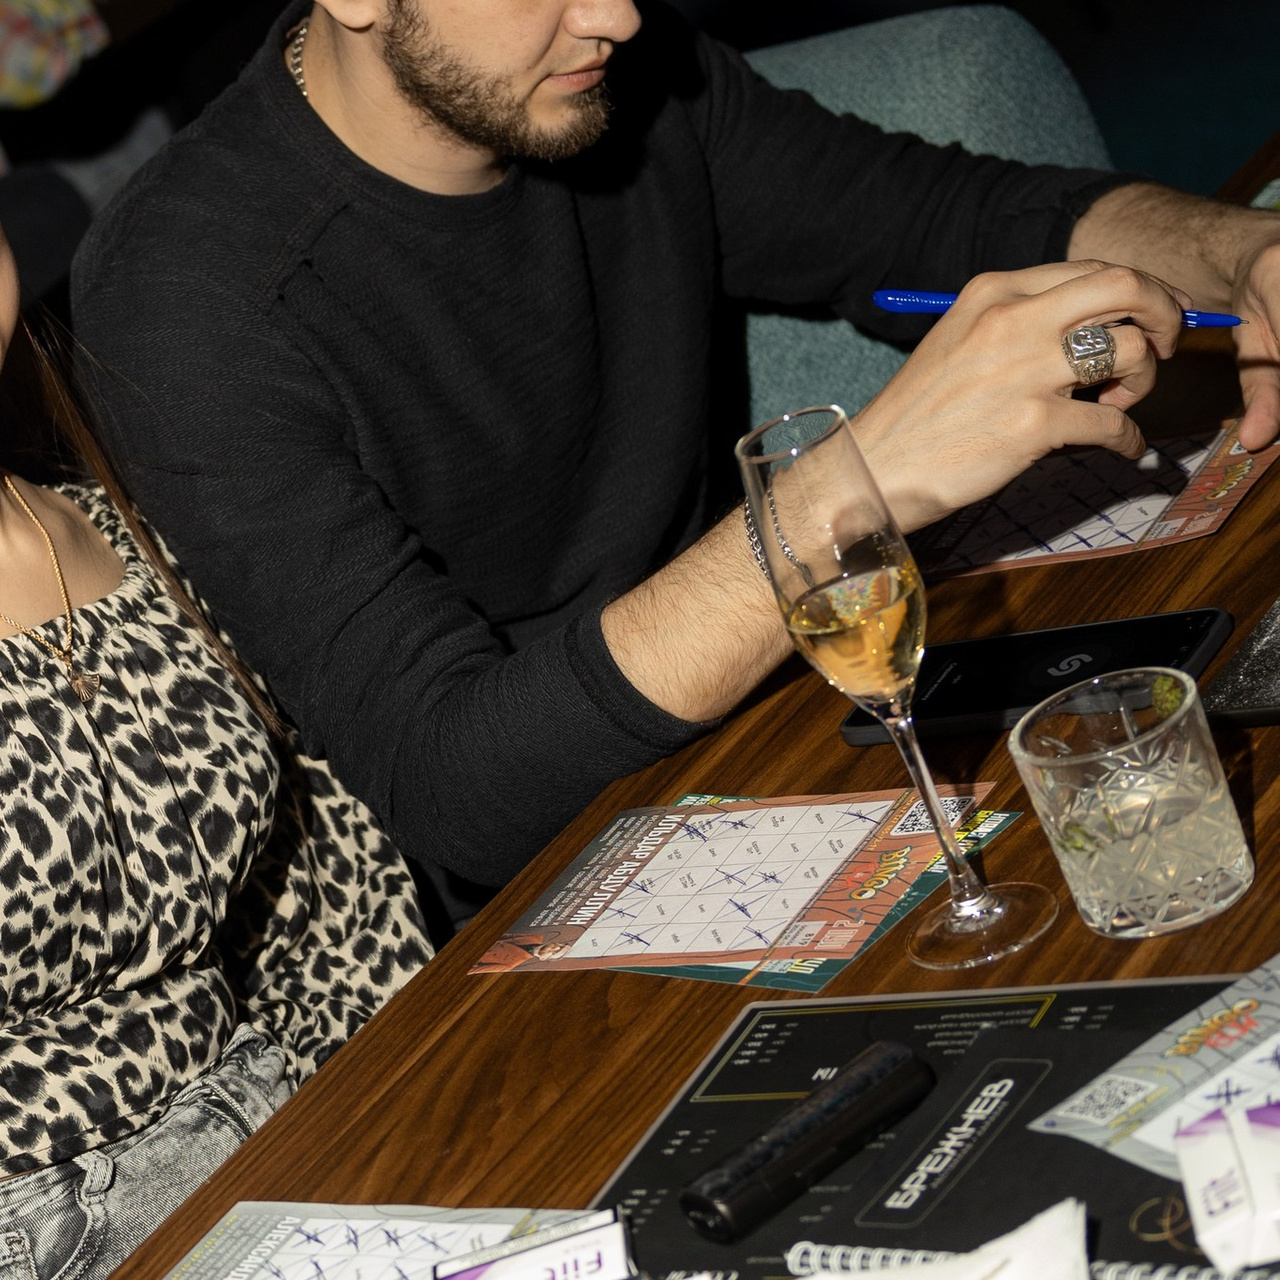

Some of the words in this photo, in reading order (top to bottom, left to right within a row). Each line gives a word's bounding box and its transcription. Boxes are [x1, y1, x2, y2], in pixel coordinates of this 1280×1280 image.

[630, 815, 685, 860] ИЛЬДАР
[566, 860, 641, 925] АБДУЛЛИН
[850, 846, 913, 900] BINGO
[884, 1078, 1015, 1209] БРЕЖНЕВ
